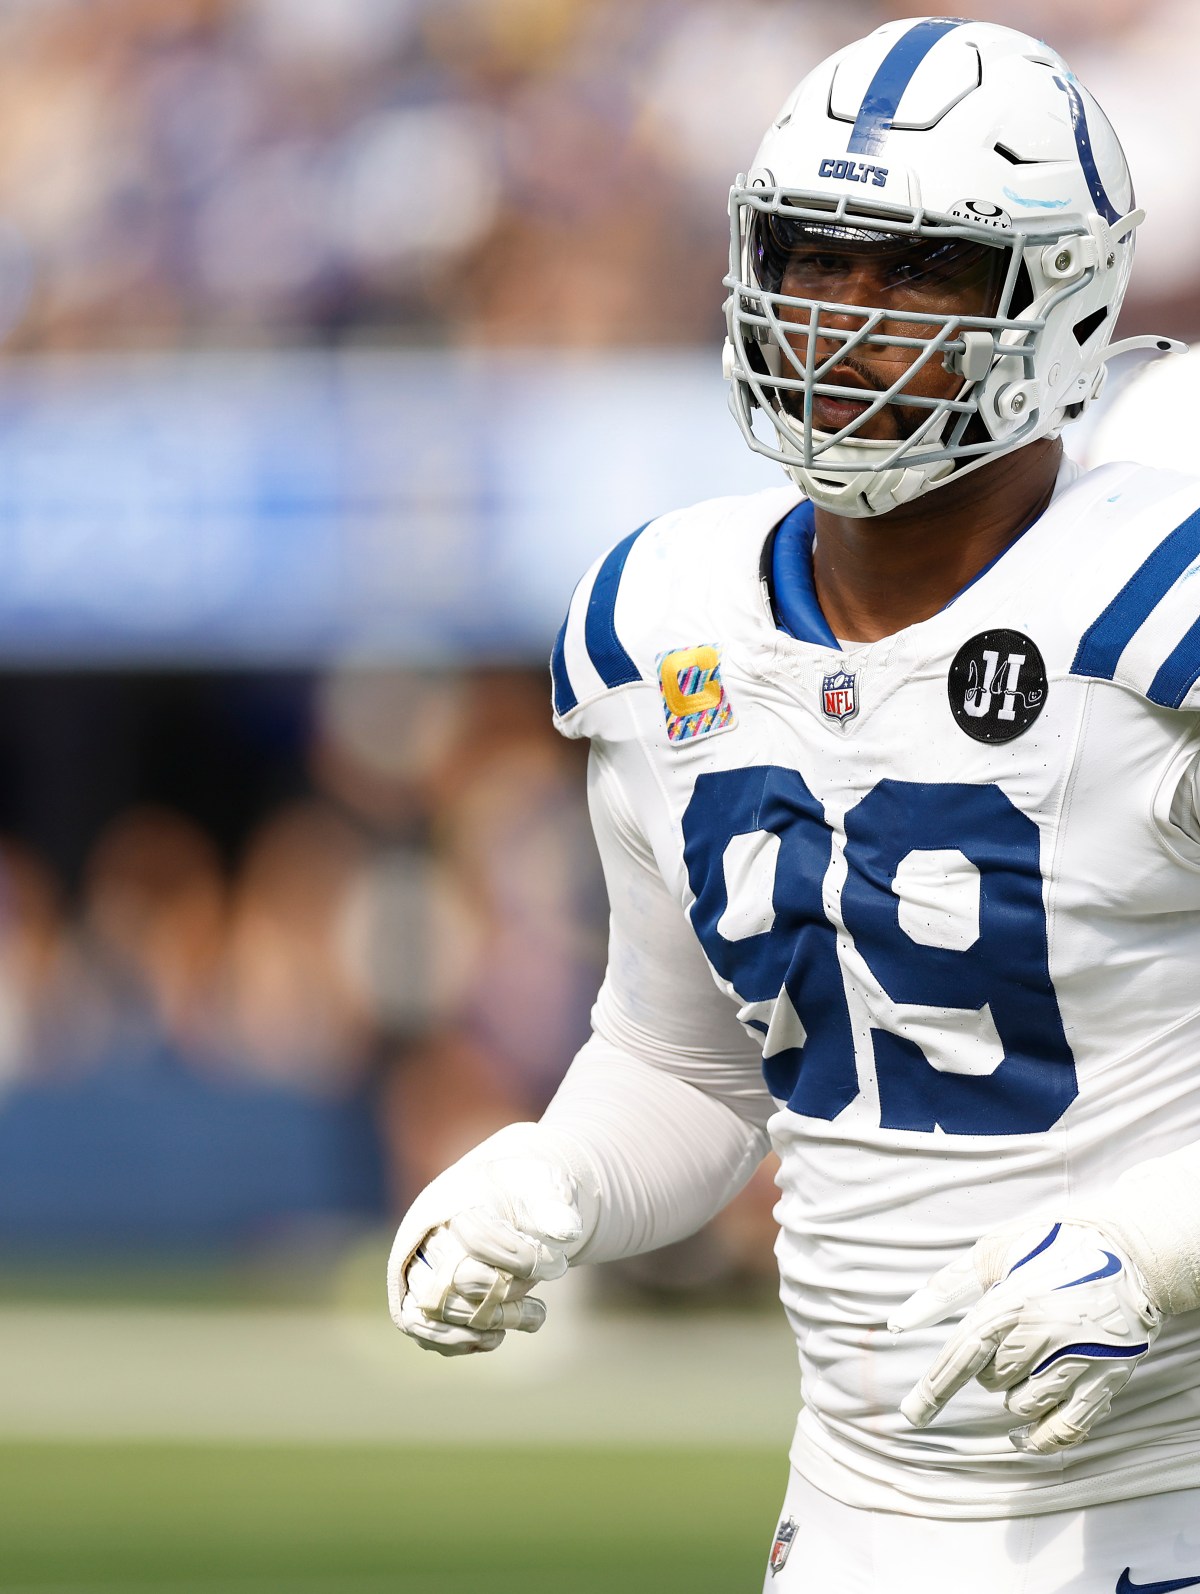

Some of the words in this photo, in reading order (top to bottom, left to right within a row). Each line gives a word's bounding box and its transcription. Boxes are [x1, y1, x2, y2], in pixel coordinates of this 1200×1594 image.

[818, 159, 889, 188] COLTS
[660, 645, 721, 717] C
[825, 690, 853, 715] NFL
[681, 765, 1079, 1136] 99
